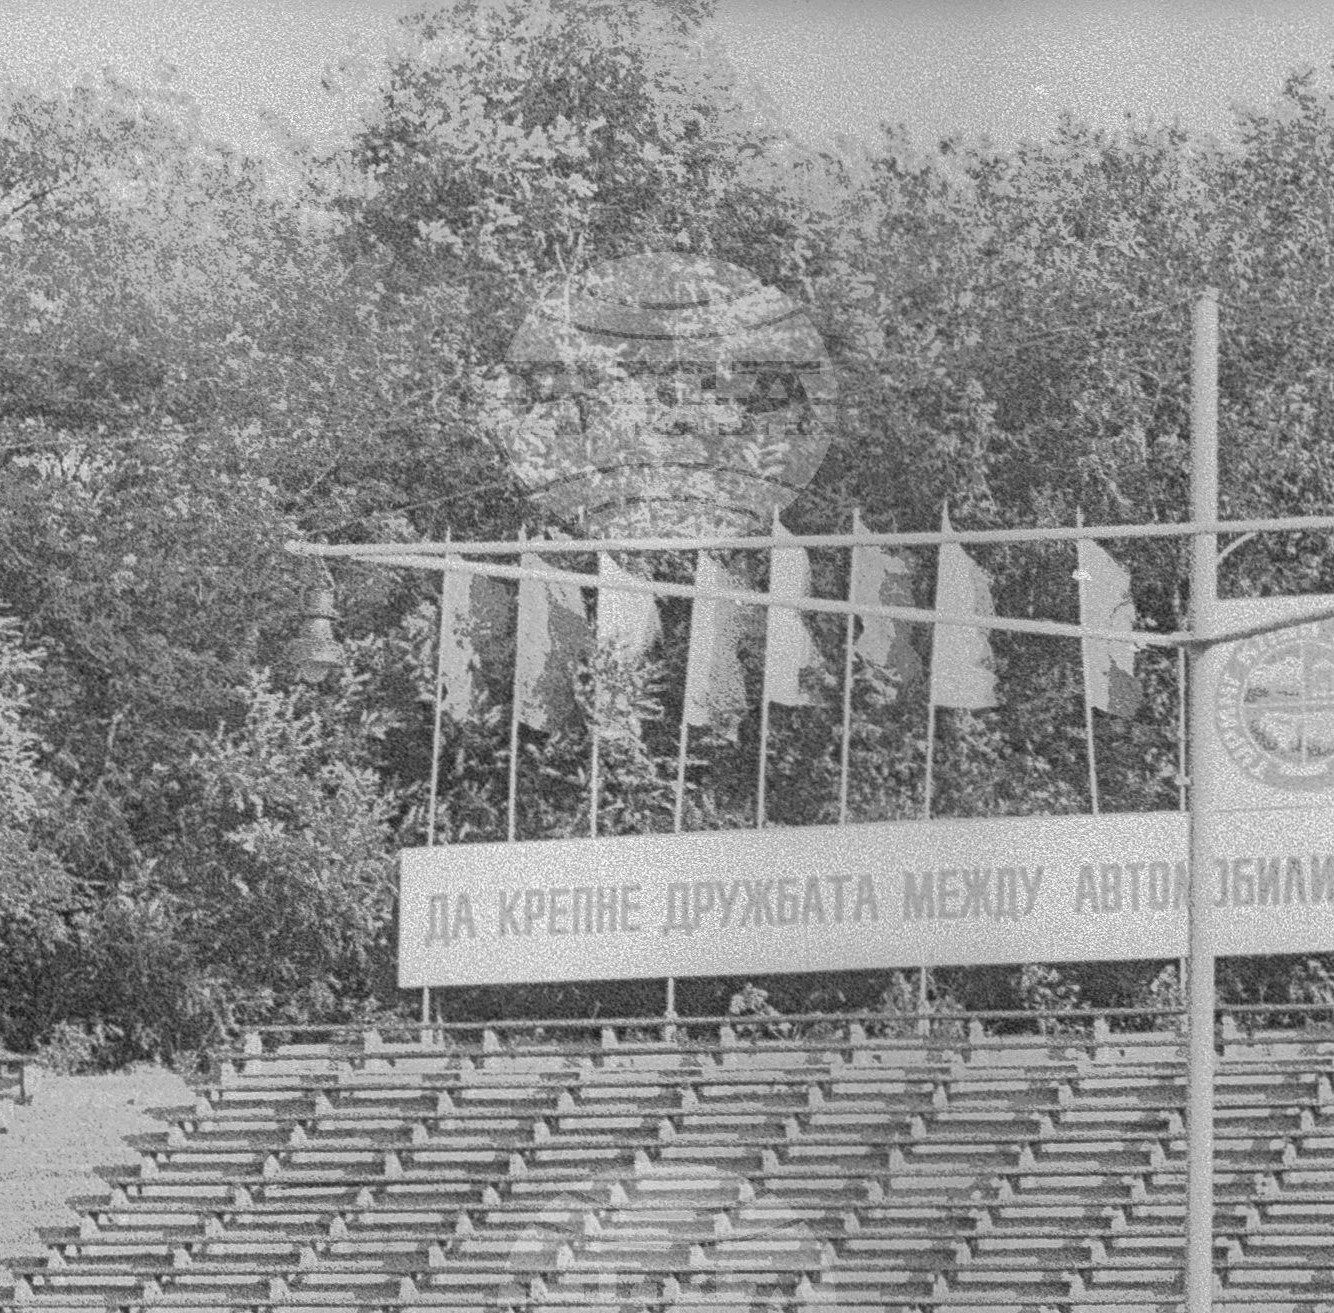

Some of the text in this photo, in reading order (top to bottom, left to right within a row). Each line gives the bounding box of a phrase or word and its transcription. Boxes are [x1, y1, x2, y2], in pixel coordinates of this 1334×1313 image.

[424, 892, 476, 946] ДА
[498, 884, 642, 937] КРЕПНЕ
[663, 874, 879, 937] ДРУЖБАТА
[902, 866, 1045, 921] МЕЖДУ
